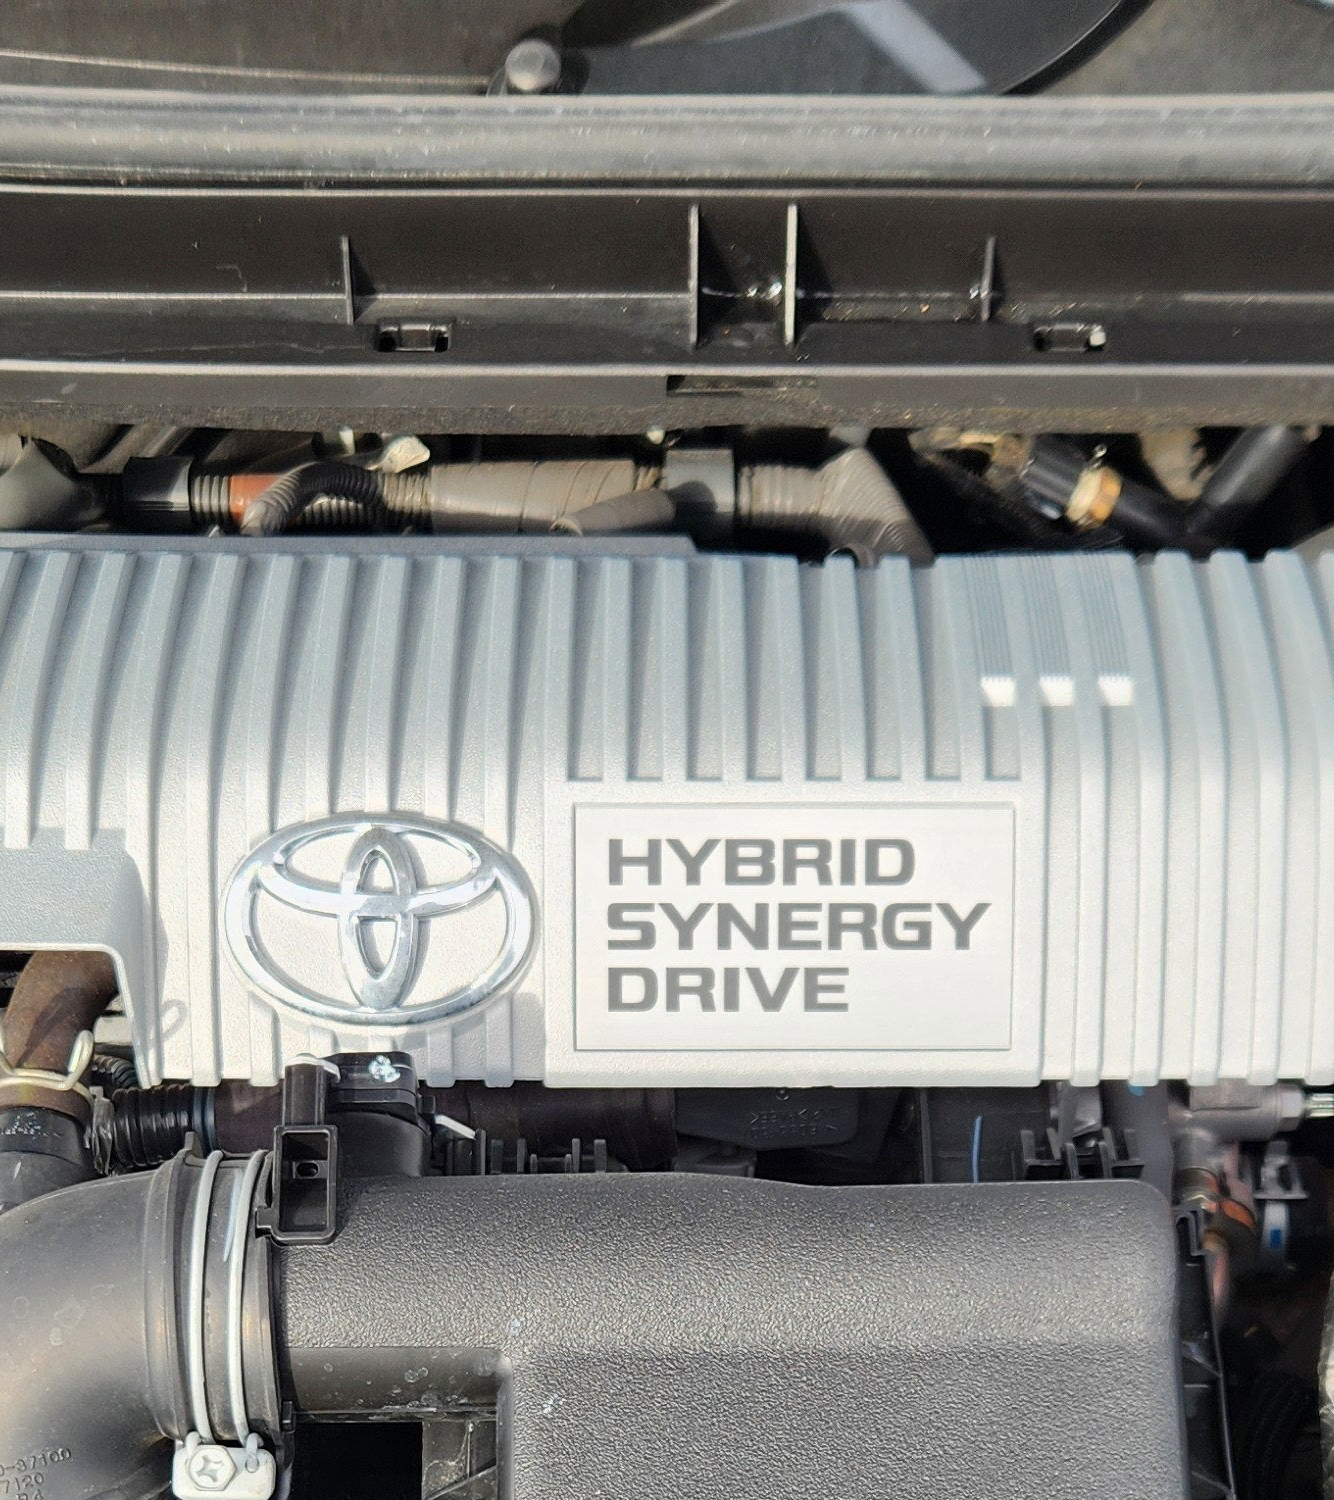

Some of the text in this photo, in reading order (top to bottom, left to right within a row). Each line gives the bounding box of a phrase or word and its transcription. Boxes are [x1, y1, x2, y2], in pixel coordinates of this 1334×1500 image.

[607, 837, 915, 886] HYBRID
[607, 902, 991, 951] SYNERGY
[607, 966, 849, 1012] DRIVE
